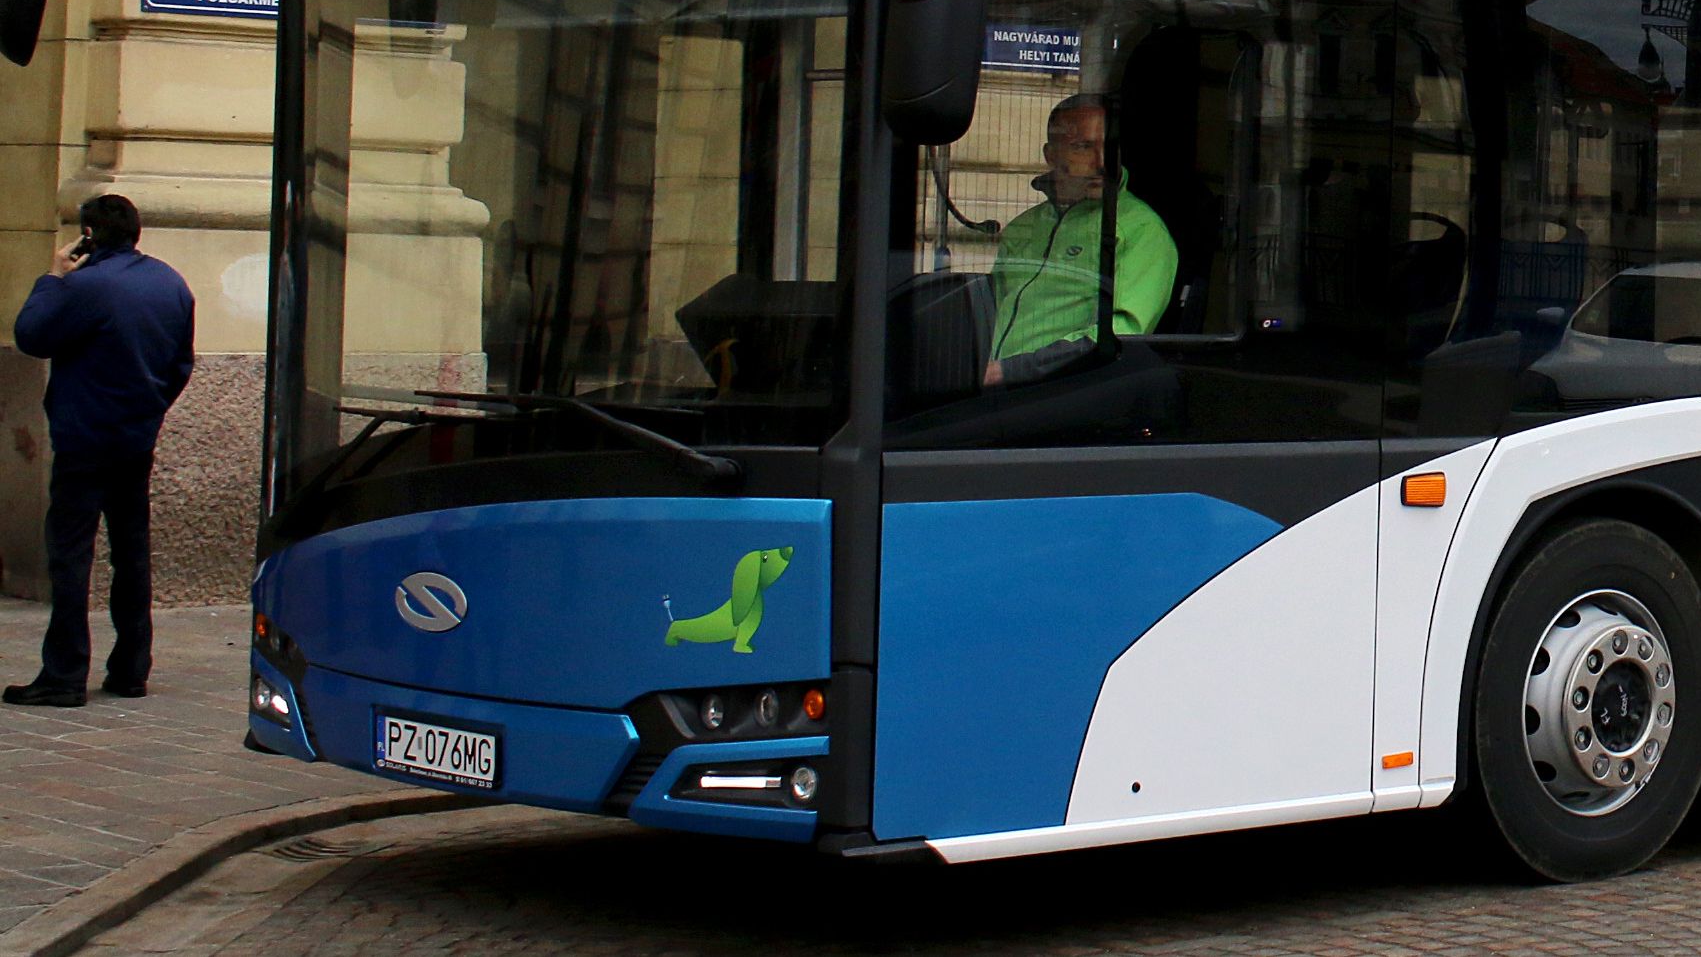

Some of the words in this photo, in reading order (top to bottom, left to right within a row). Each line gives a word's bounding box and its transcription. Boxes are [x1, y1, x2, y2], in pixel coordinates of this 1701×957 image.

[994, 31, 1060, 45] NAGYVÁRAD
[1019, 50, 1050, 61] HELYI
[1053, 51, 1080, 63] TANÁ
